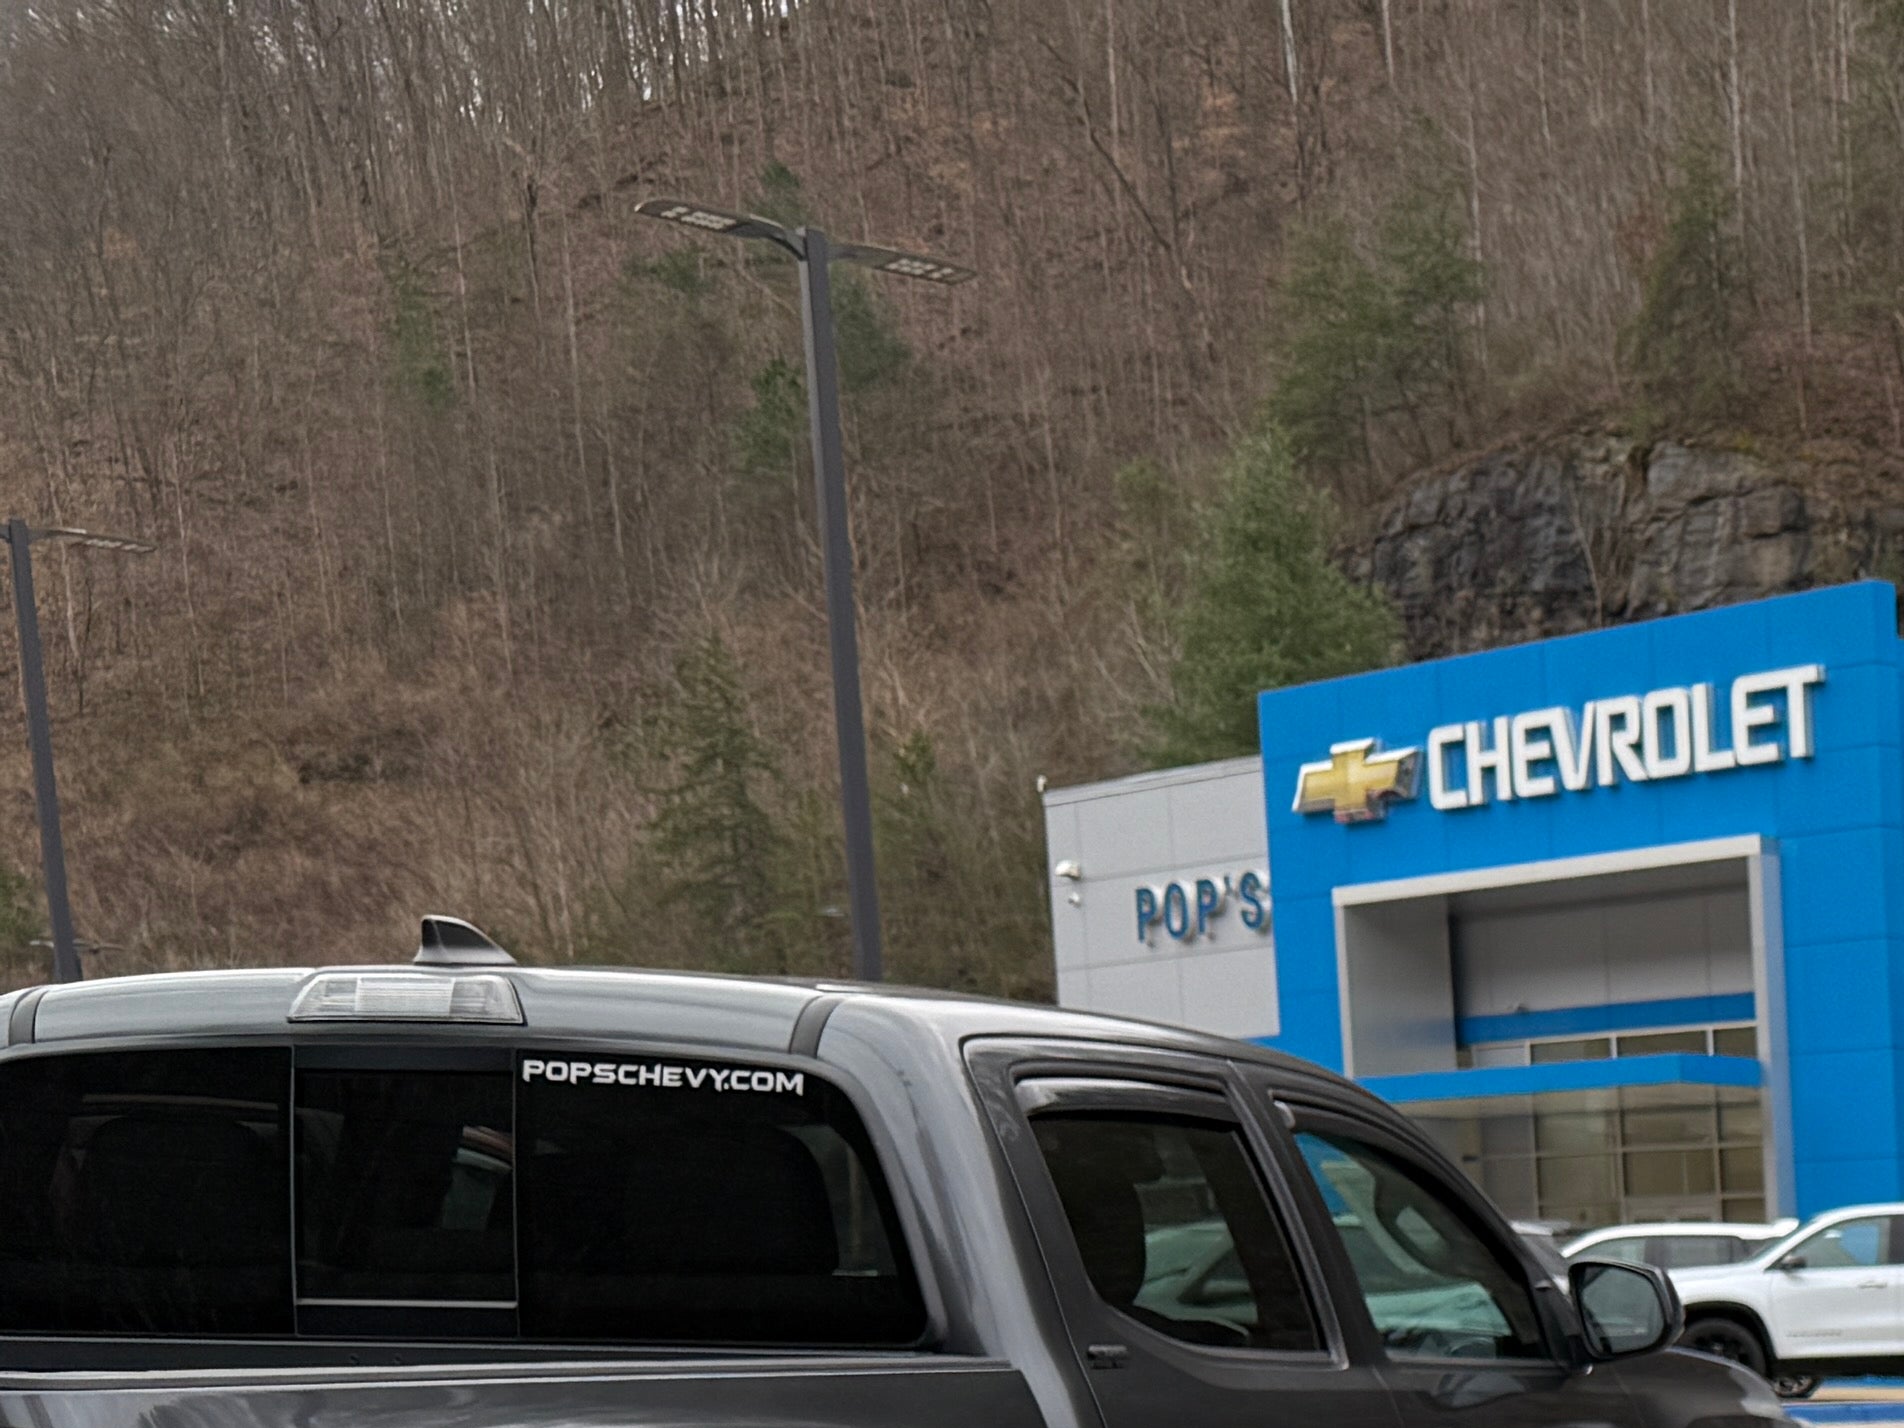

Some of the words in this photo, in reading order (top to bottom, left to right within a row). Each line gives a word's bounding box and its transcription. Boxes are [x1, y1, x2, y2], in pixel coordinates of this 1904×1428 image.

[1427, 664, 1825, 811] CHEVROLET
[1135, 872, 1266, 943] POP'S
[521, 1058, 804, 1096] POPSCHEVY.COM
